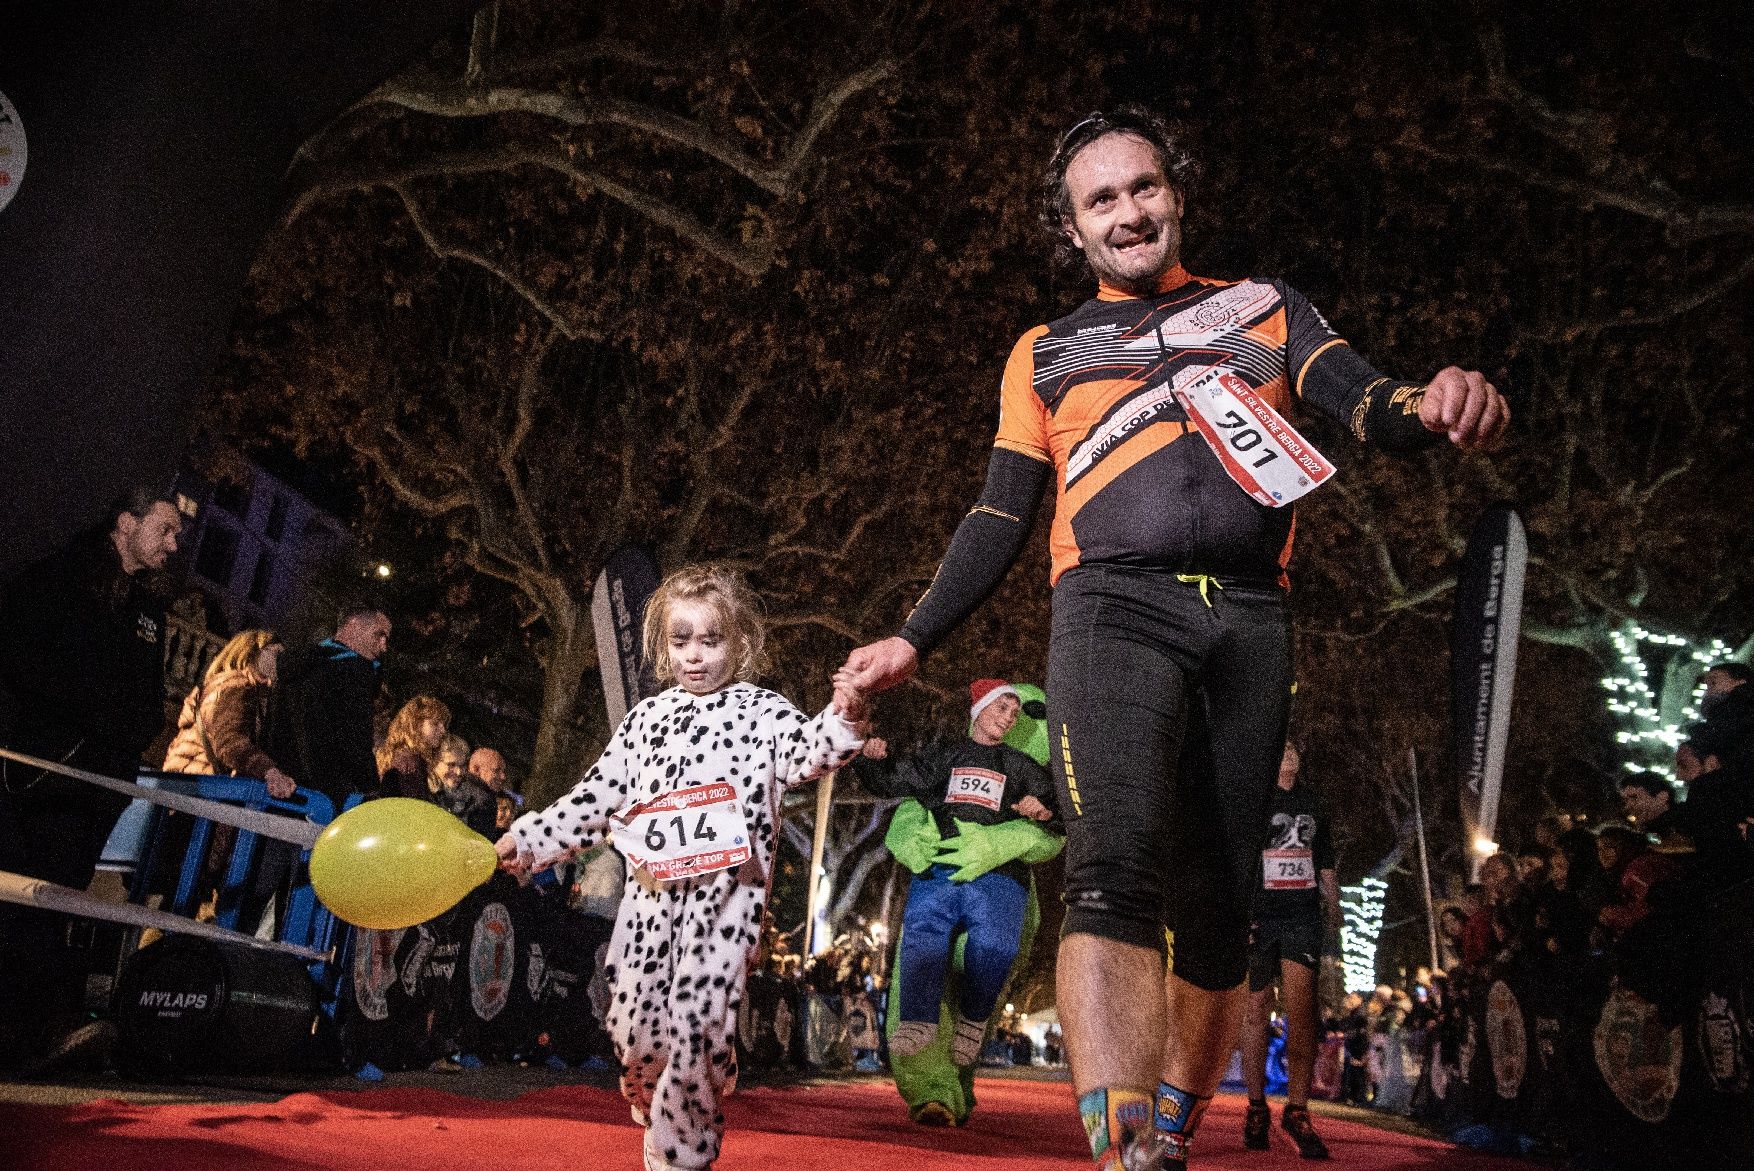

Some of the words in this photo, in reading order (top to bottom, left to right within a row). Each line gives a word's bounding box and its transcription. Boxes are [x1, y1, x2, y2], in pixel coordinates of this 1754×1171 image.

[1121, 410, 1151, 433] COP
[1228, 378, 1249, 401] SANT
[1245, 396, 1282, 437] SILVESTRE
[1277, 431, 1303, 457] BERGA
[1298, 454, 1323, 475] 2022
[1215, 410, 1279, 469] 701
[1483, 545, 1504, 618] Berga
[1482, 622, 1496, 654] de
[1466, 662, 1492, 795] Ajuntament
[709, 787, 729, 799] 2022
[961, 777, 991, 794] 594
[645, 812, 717, 851] 614
[704, 853, 724, 863] TOR
[1278, 862, 1304, 876] 736
[139, 991, 208, 1009] MYLAPS
